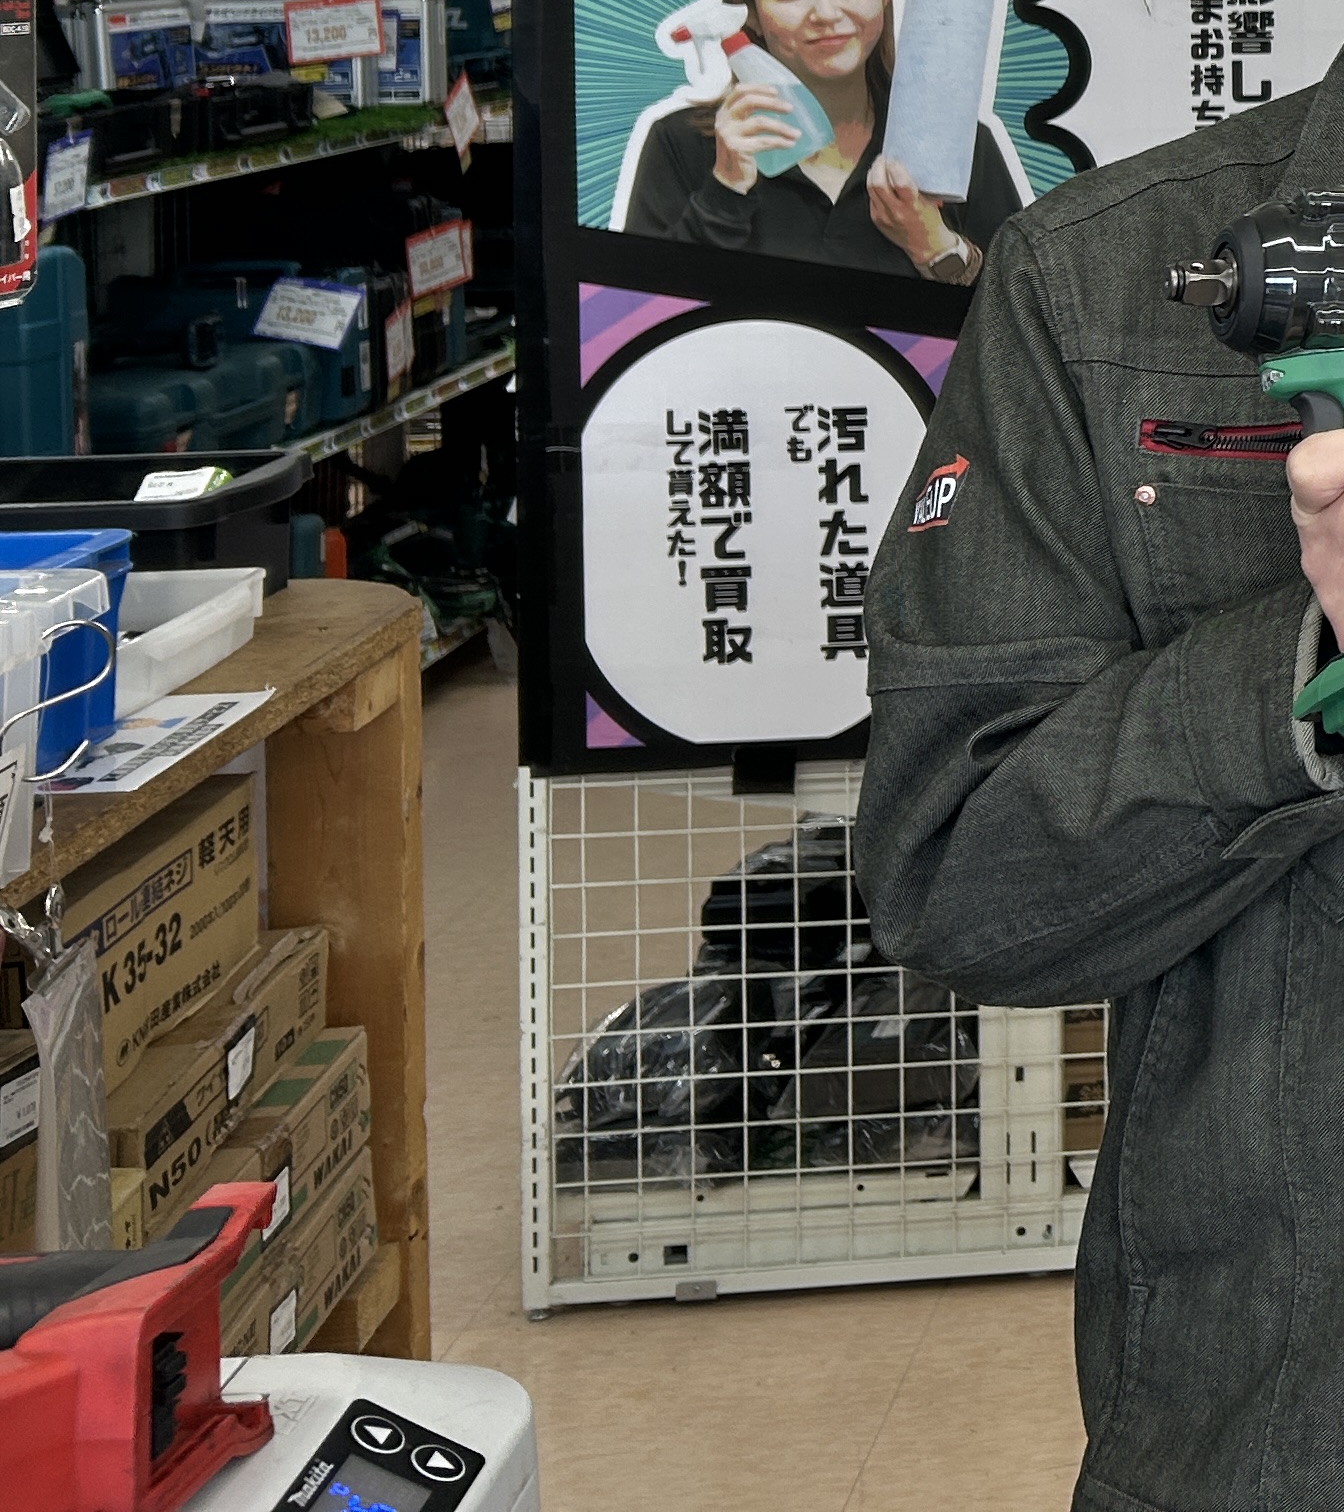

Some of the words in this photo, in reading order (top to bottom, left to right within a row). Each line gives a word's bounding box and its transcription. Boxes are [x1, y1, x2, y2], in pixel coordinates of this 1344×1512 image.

[784, 405, 814, 464] でも
[697, 408, 753, 666] 満額で買取
[816, 405, 870, 661] 汚れた道具
[101, 961, 121, 1014] K
[123, 911, 183, 995] 35-32
[149, 1137, 202, 1212] N50
[312, 1131, 353, 1191] WAKAI
[323, 1245, 363, 1311] WAKAI
